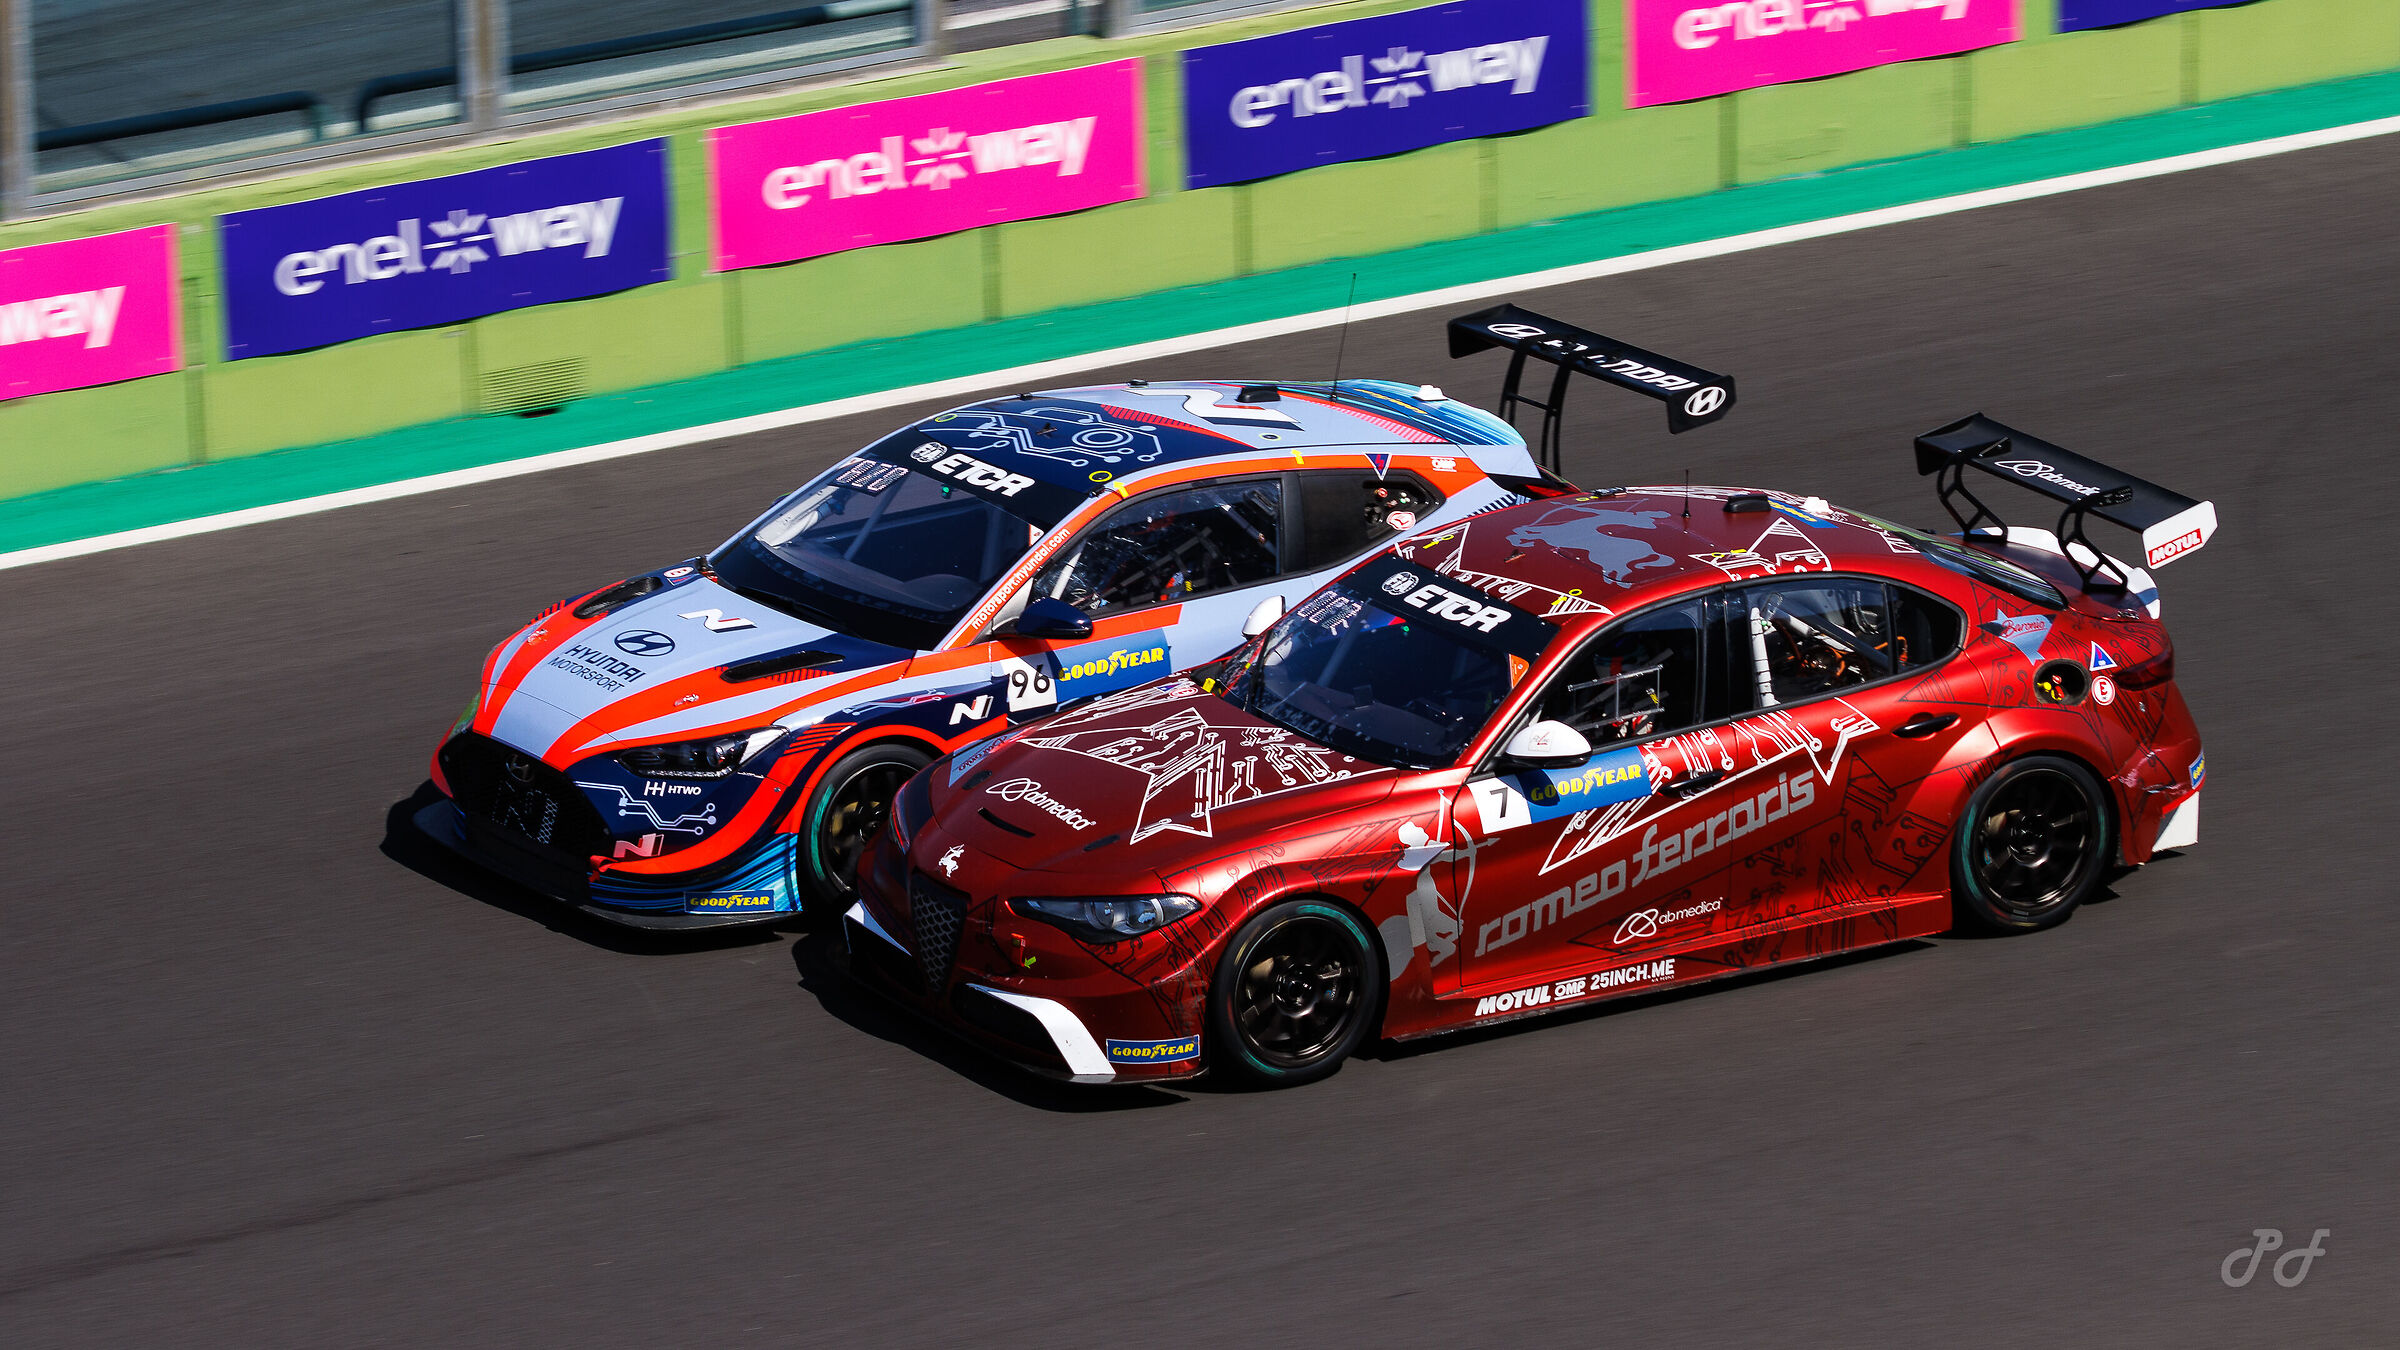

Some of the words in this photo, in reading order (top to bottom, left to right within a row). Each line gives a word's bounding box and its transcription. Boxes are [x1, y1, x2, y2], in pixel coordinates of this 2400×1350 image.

[1228, 55, 1370, 128] enel
[1426, 36, 1549, 95] way
[761, 136, 908, 209] enel
[968, 116, 1098, 176] way
[273, 217, 426, 296] enel
[490, 197, 624, 259] way
[932, 453, 1035, 497] ETCR
[2151, 530, 2201, 563] MOTUL
[1403, 584, 1512, 633] ETCR
[548, 656, 625, 693] MOTORSPORT
[565, 644, 646, 682] HYUNDAI
[1009, 664, 1050, 698] 96
[950, 694, 993, 725] N
[668, 785, 702, 796] HTWO
[1489, 787, 1508, 818] 7
[1475, 859, 1627, 957] romeo
[1632, 769, 1815, 888] ferraris
[1554, 978, 1586, 999] OMP
[1590, 958, 1675, 990] 25INCH.ME
[1475, 985, 1551, 1016] MOTUL
